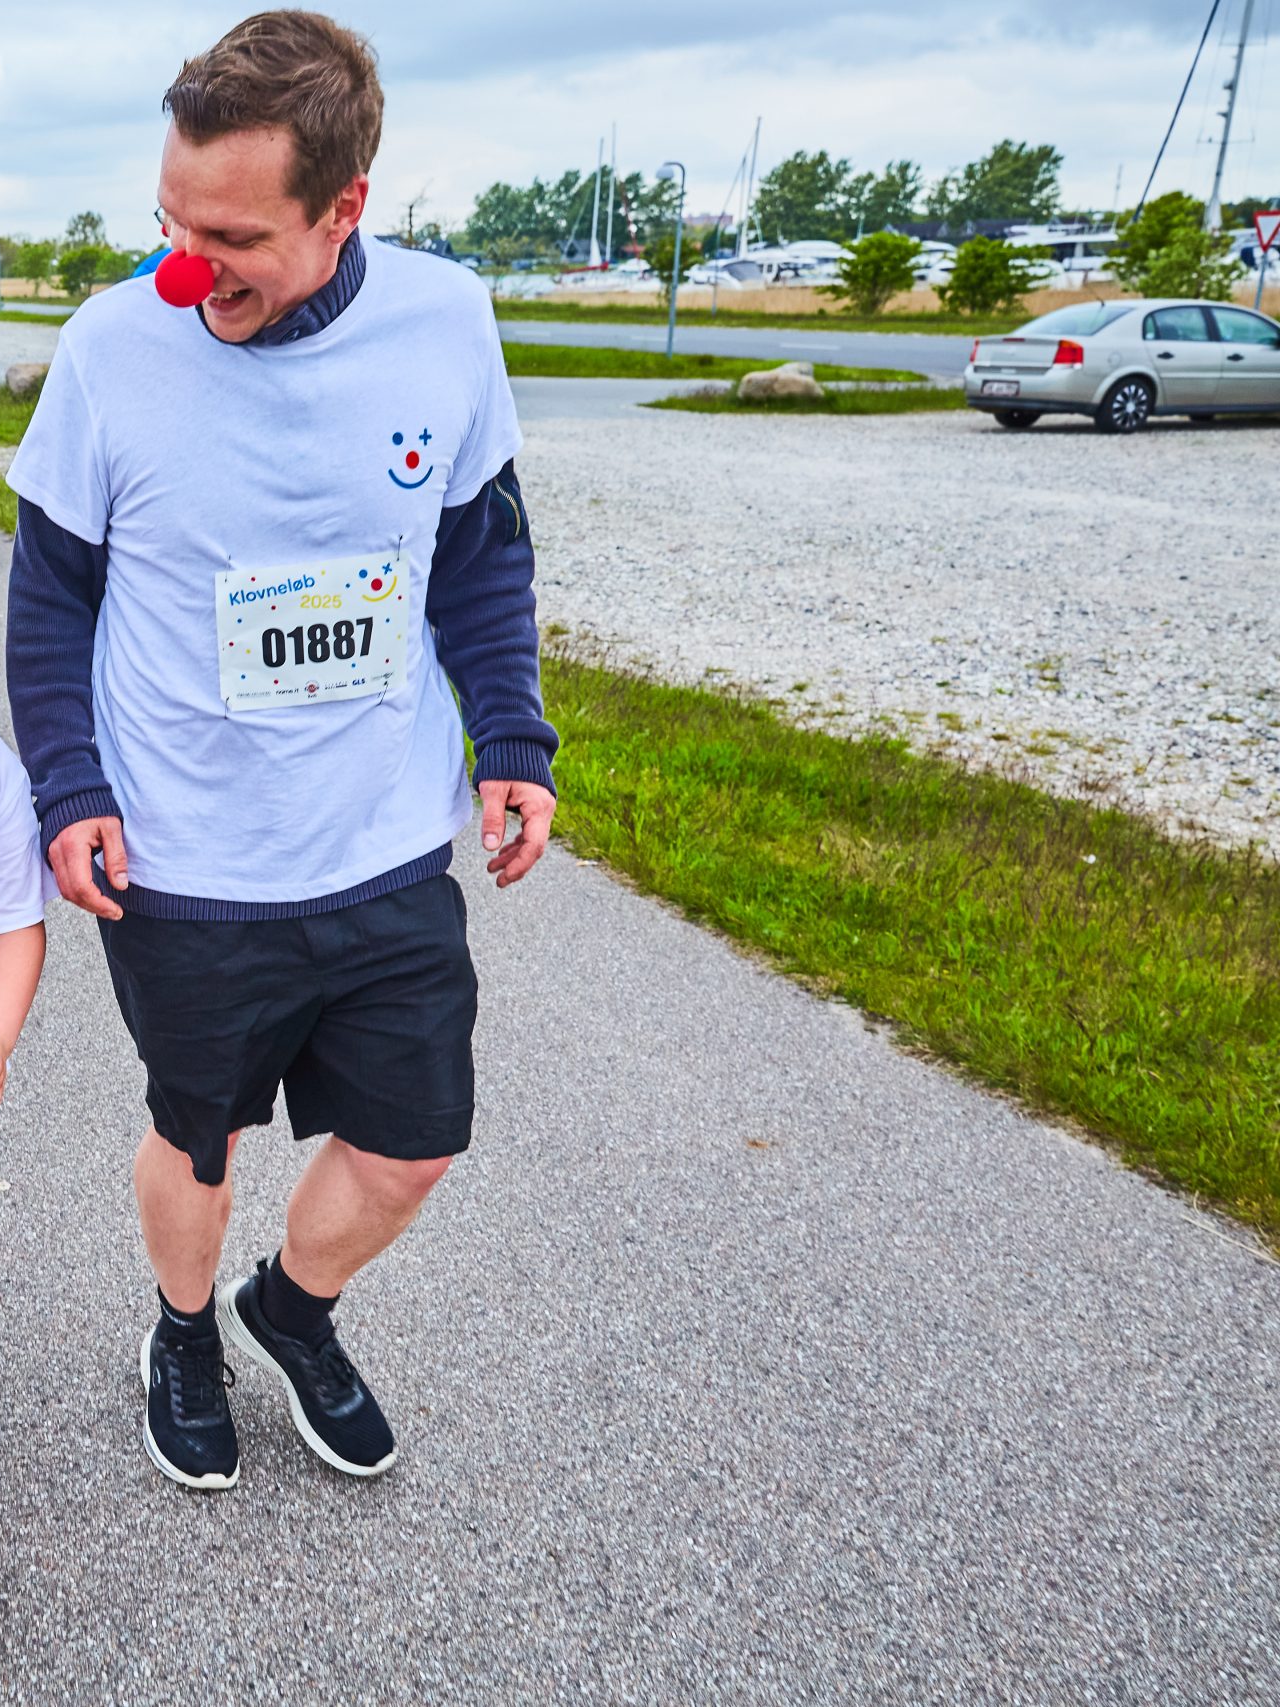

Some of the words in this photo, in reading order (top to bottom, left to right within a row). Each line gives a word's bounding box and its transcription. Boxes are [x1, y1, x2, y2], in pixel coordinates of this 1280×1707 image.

[229, 574, 315, 607] Klovneløb
[300, 594, 342, 609] 2025
[261, 616, 374, 669] 01887
